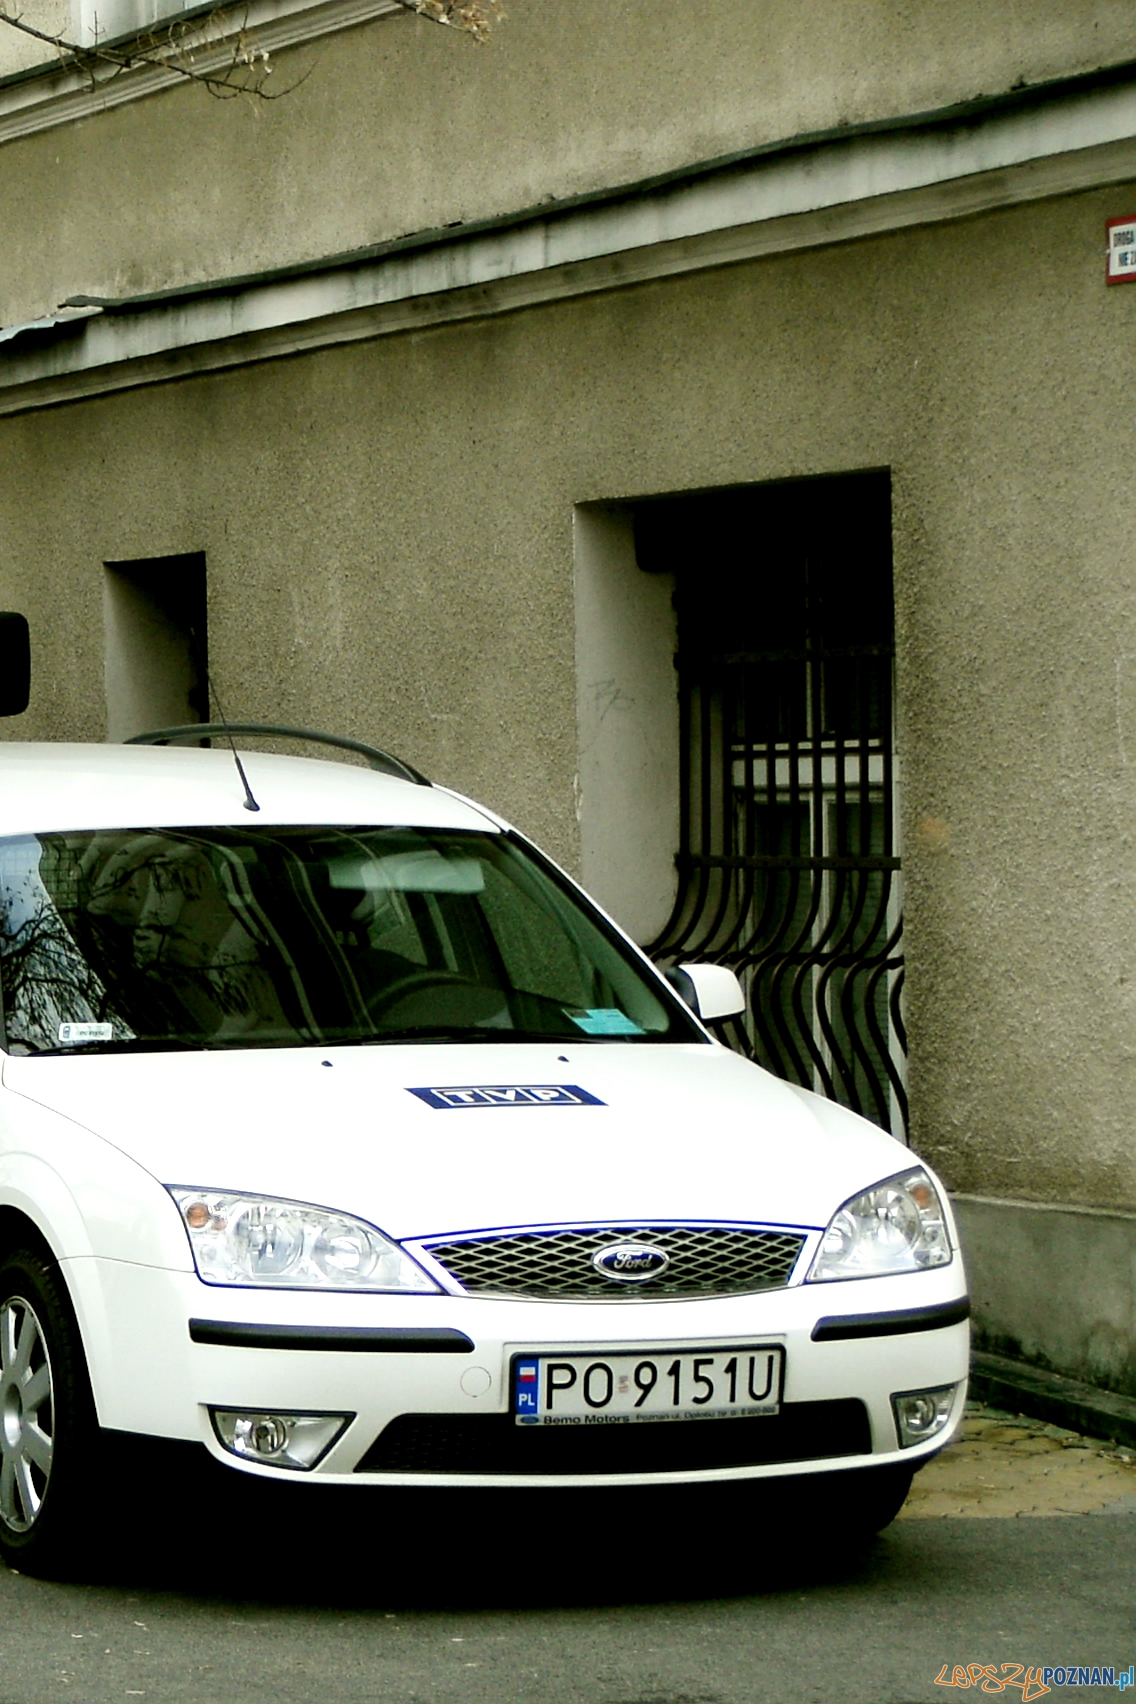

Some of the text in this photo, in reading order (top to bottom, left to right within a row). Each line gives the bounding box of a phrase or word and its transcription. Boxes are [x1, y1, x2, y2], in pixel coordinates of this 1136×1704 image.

[443, 1088, 560, 1103] TVP
[613, 1251, 653, 1269] Ford
[546, 1353, 775, 1410] PO 9151U
[518, 1392, 536, 1407] PL
[584, 1413, 630, 1424] Motors
